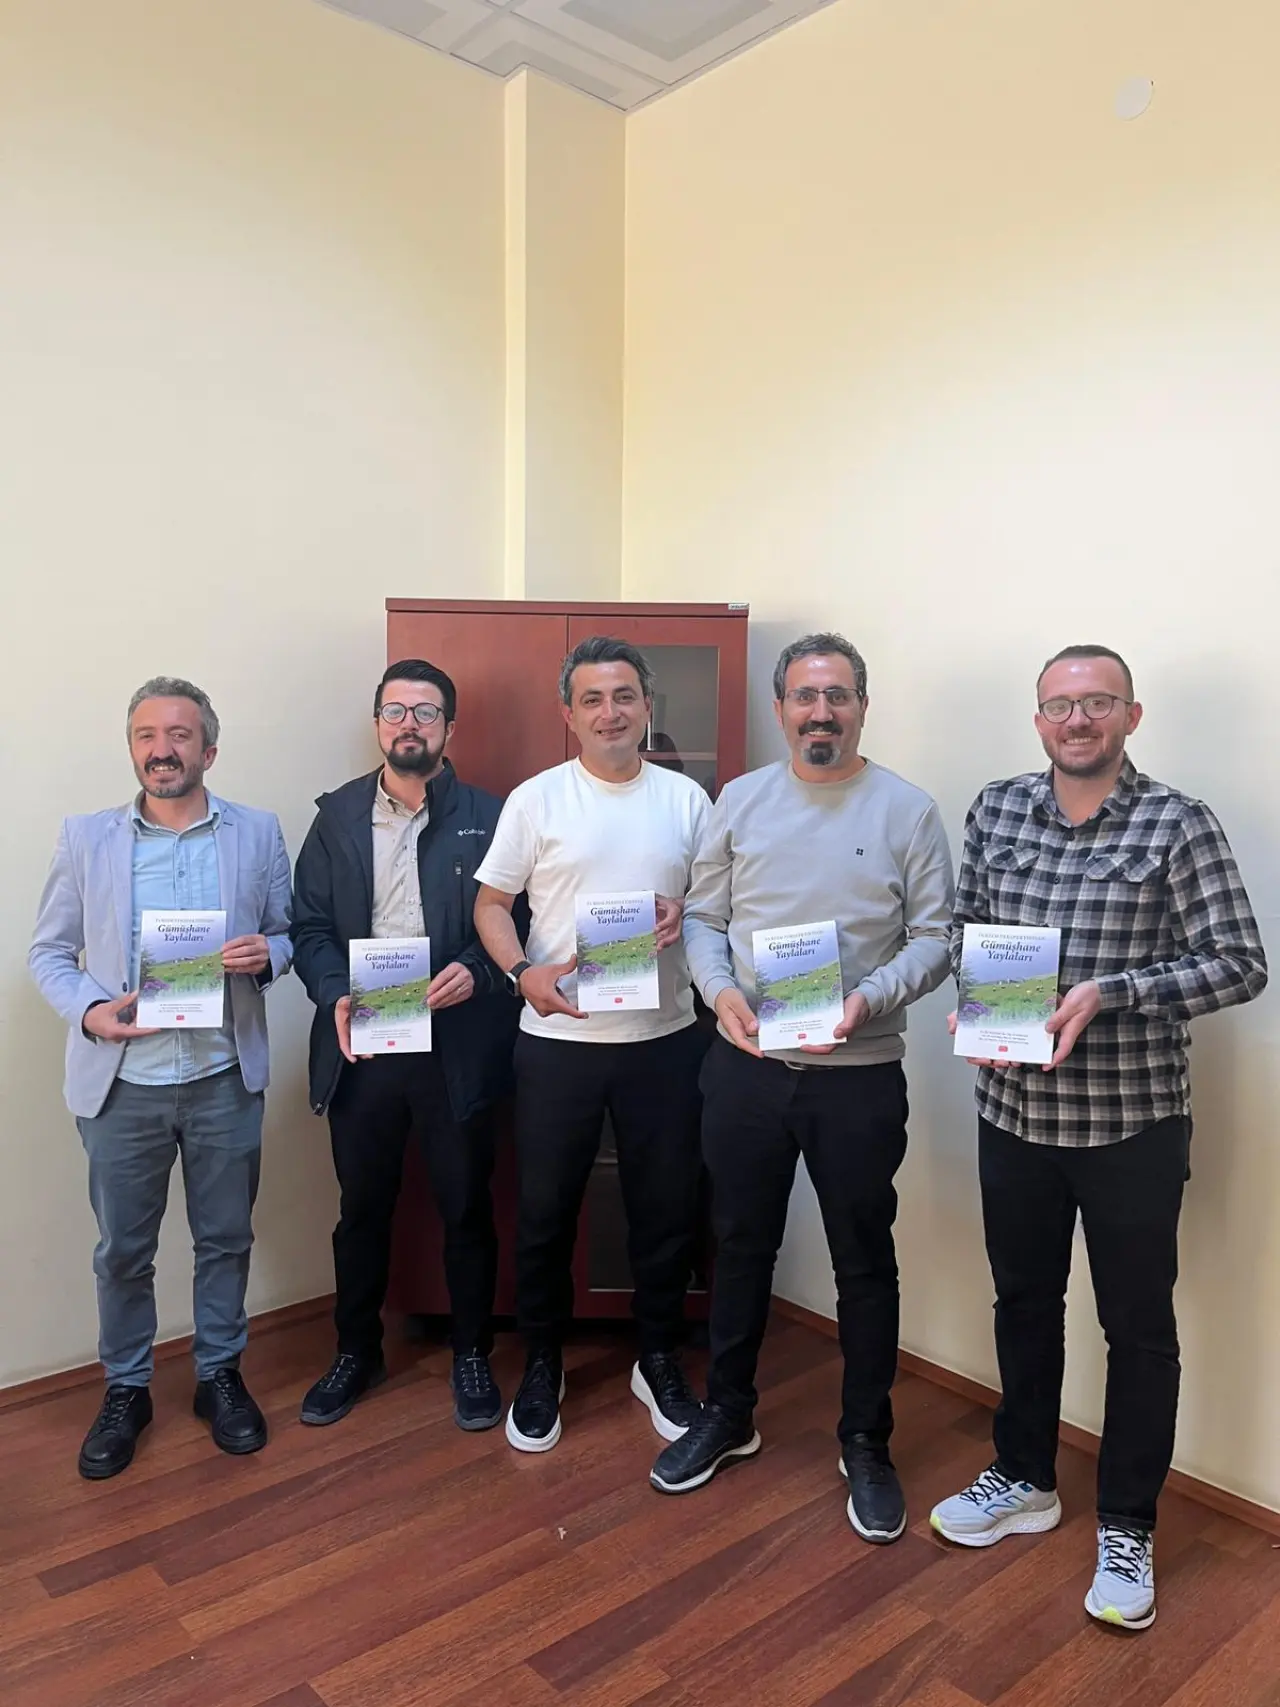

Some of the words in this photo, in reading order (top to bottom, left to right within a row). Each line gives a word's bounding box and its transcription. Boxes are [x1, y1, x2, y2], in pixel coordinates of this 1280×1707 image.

[590, 906, 641, 916] Gümüşhane
[596, 915, 636, 926] Yaylaları
[157, 924, 211, 934] Gümüşhane
[164, 933, 205, 944] Yaylaları
[768, 938, 821, 951] Gümüşhane
[980, 940, 1042, 953] Gümüşhane
[775, 948, 815, 960] Yaylaları
[987, 950, 1033, 962] Yaylaları
[371, 961, 409, 972] Yaylaları
